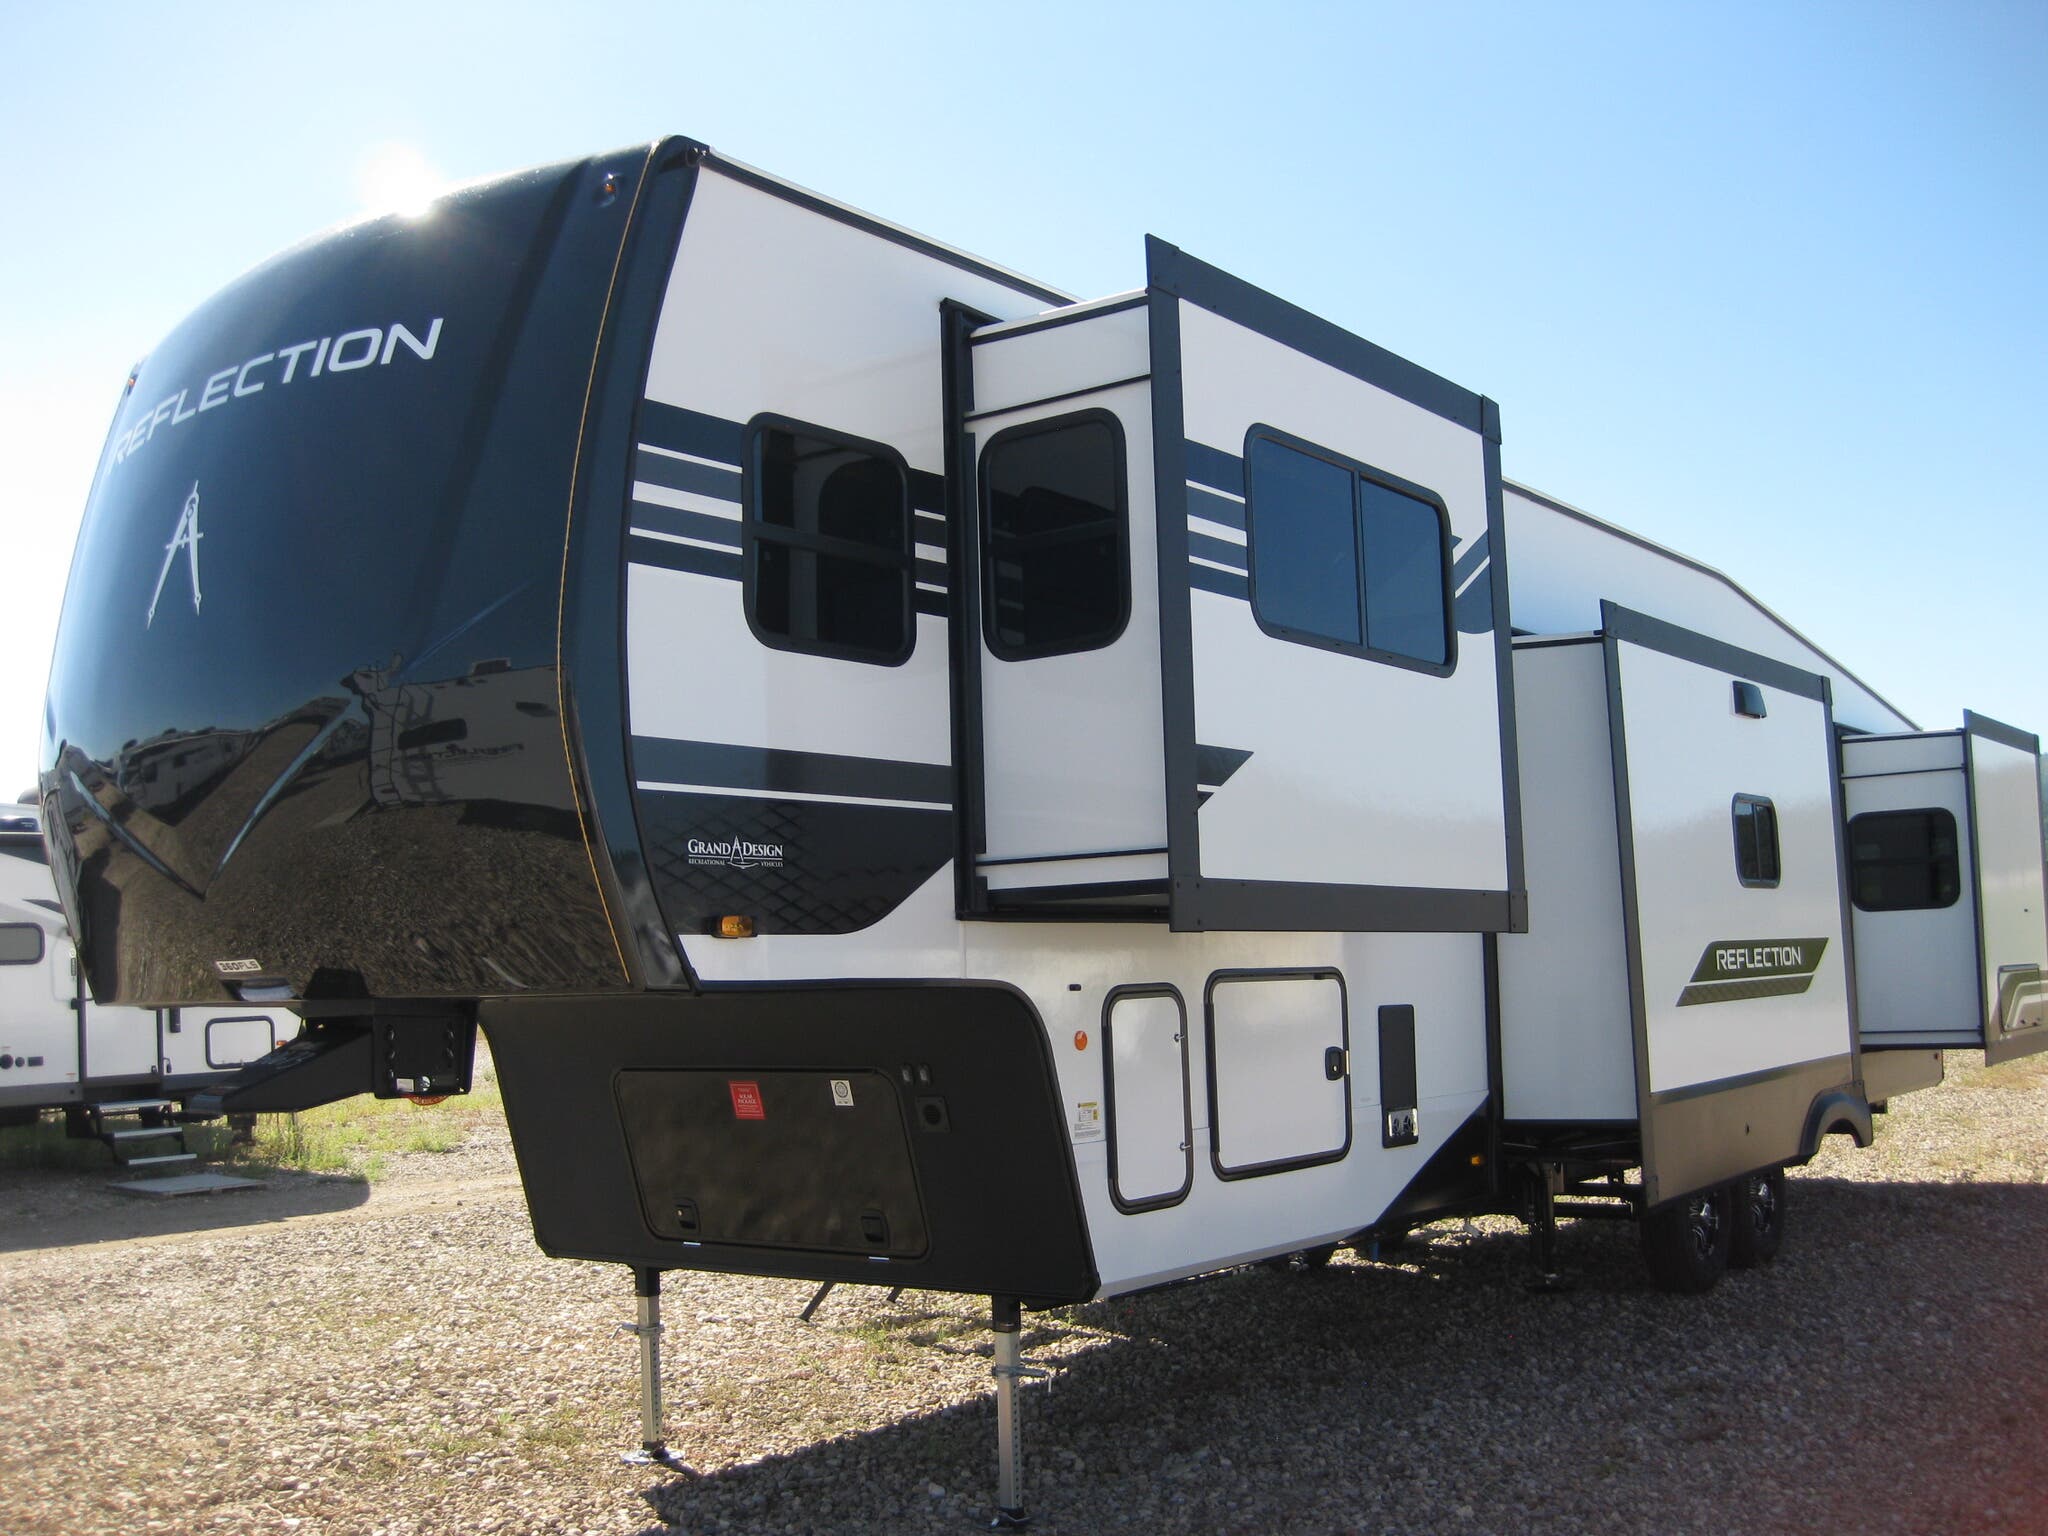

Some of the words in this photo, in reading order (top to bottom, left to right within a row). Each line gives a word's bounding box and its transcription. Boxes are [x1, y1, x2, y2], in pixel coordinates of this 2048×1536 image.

[107, 318, 444, 474] REFLECTION
[687, 838, 731, 856] GRAND
[743, 841, 783, 857] DESIGN
[1716, 946, 1801, 970] REFLECTION
